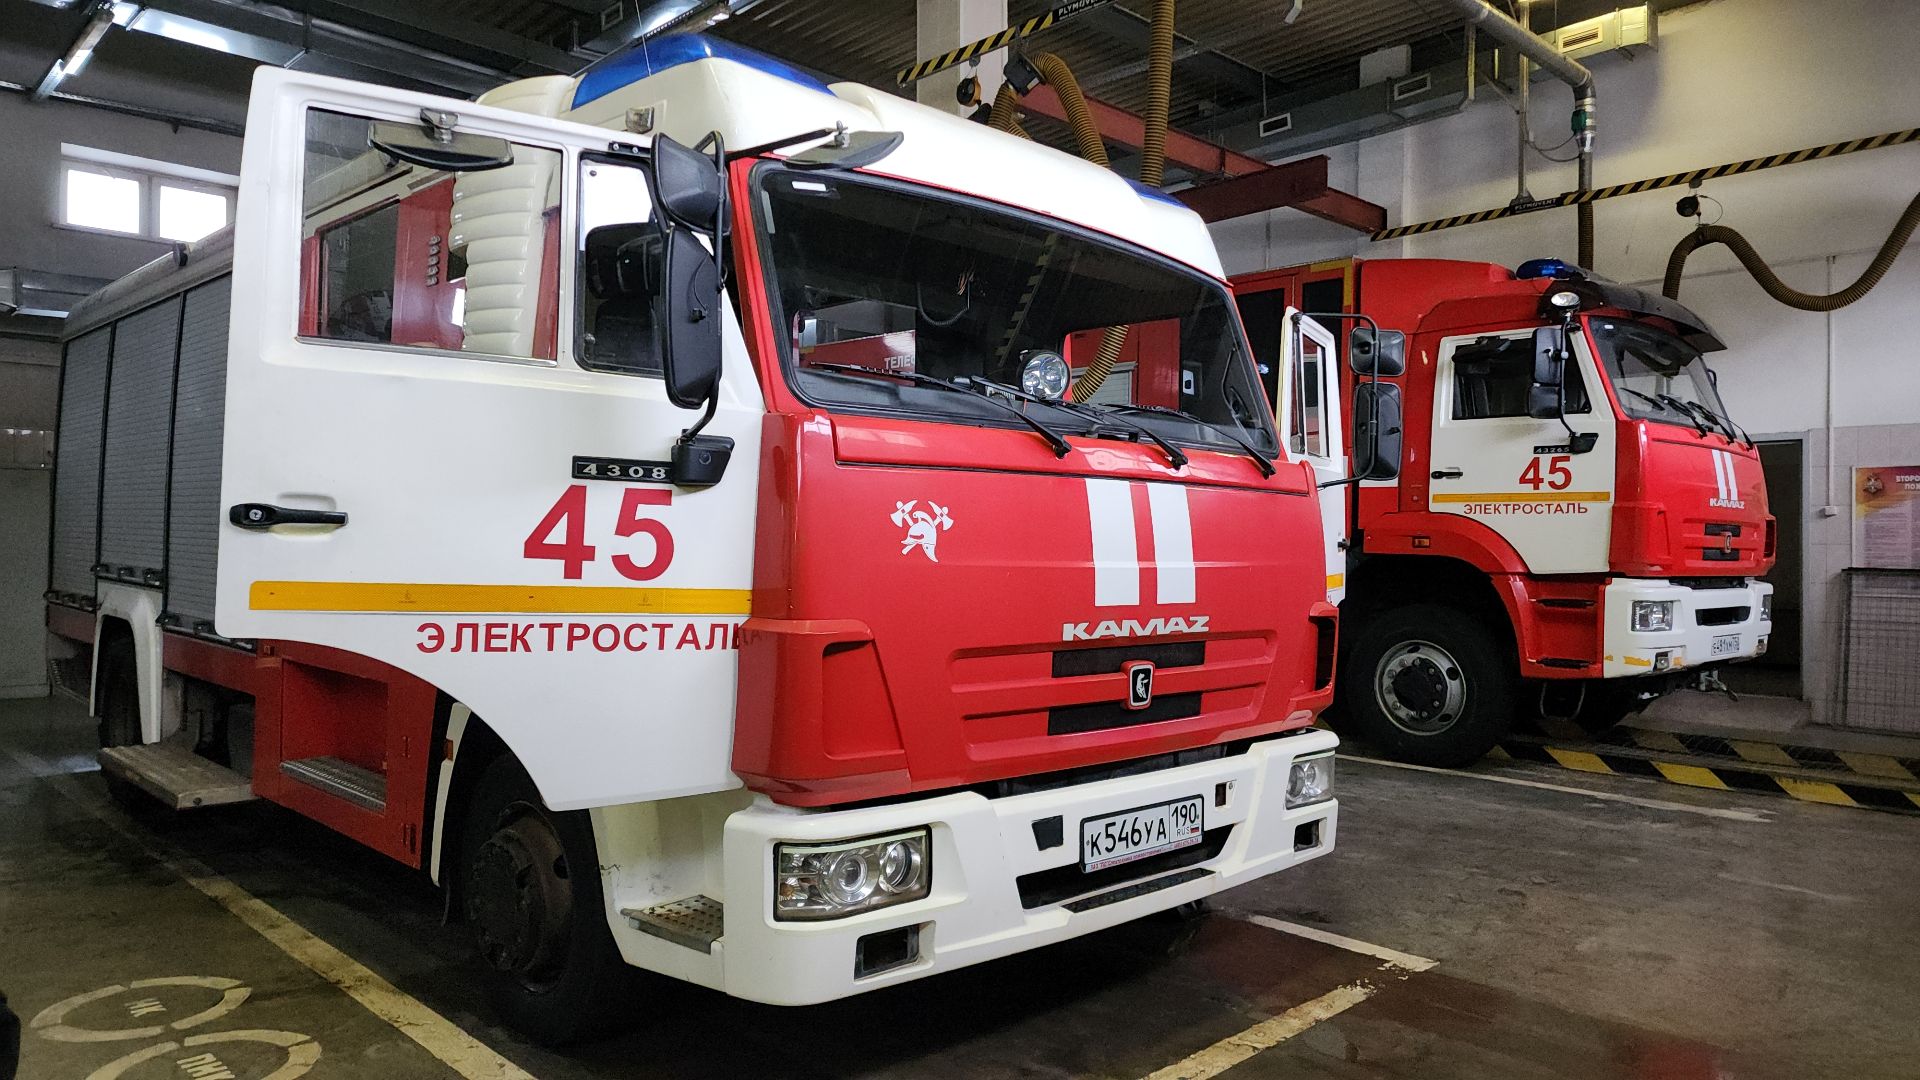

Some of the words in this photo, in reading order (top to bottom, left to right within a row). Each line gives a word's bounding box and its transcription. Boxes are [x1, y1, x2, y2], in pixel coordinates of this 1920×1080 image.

[1058, 0, 1098, 16] PLYMOV
[582, 463, 667, 480] 4308
[1518, 455, 1573, 491] 45
[1463, 502, 1588, 515] ЭЛЕКТРОСТАЛЬ
[1709, 498, 1745, 509] KAMAZ
[523, 484, 675, 581] 45
[1062, 615, 1210, 641] KAMAZ
[1090, 816, 1167, 858] К546УА
[1171, 802, 1197, 829] 190
[1176, 827, 1190, 837] RUS
